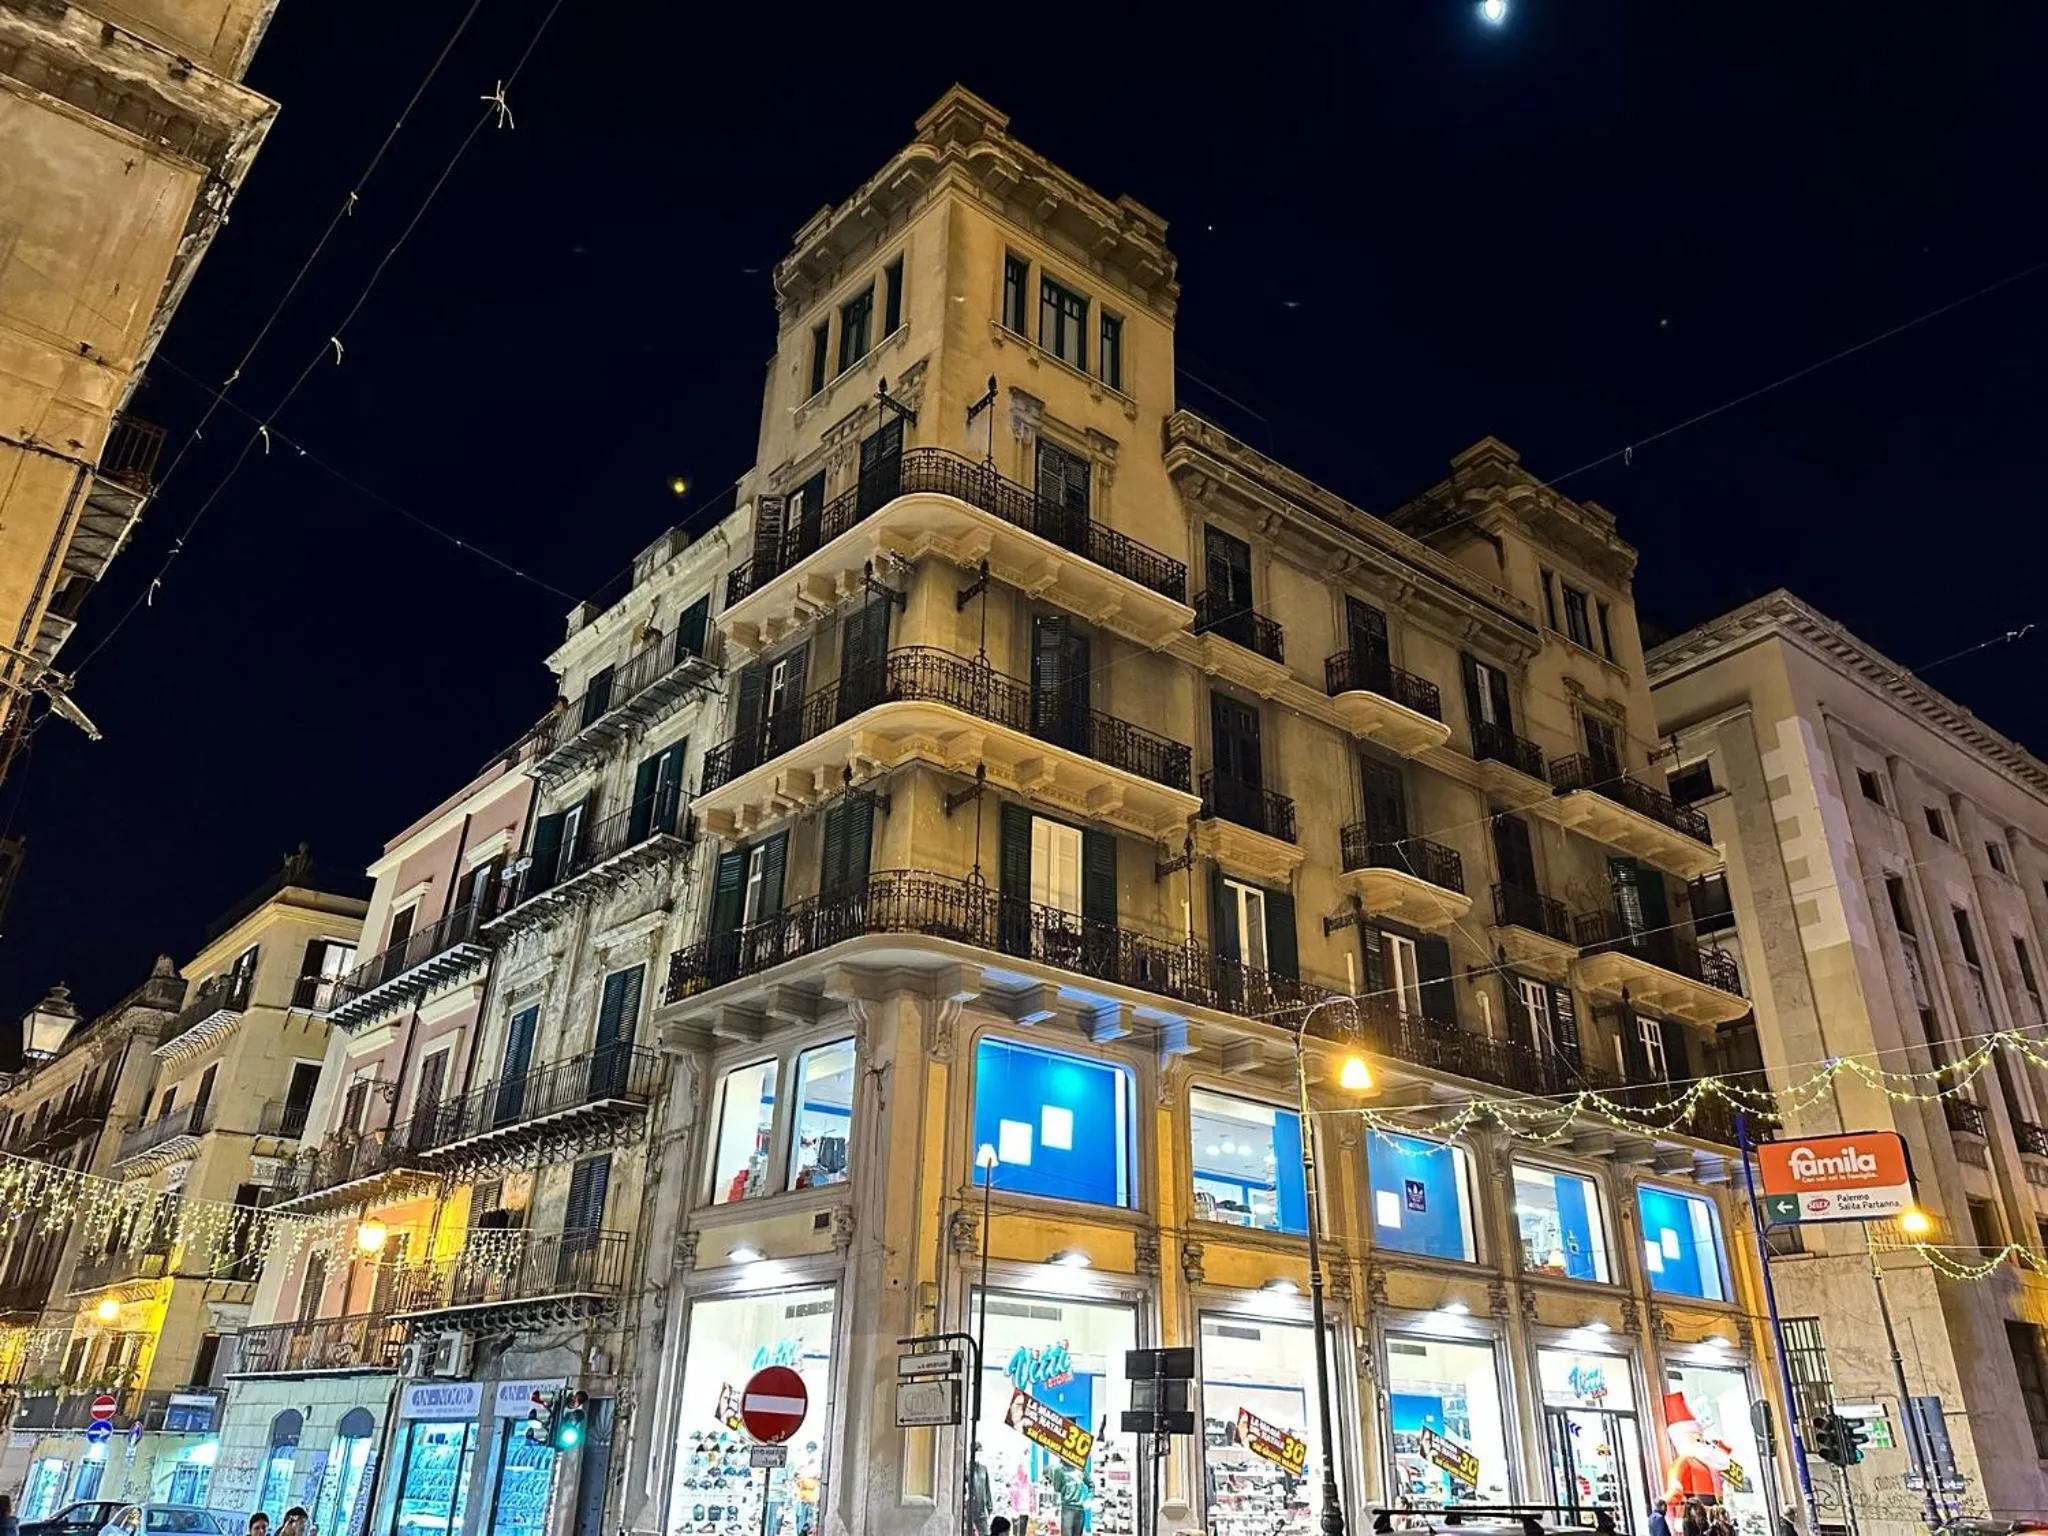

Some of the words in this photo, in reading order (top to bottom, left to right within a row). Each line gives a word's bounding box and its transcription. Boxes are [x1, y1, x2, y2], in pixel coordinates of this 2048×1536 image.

[1788, 1146, 1877, 1180] famila
[1837, 1193, 1870, 1202] Palermo
[1838, 1201, 1861, 1211] Salita
[1063, 1424, 1091, 1456] 30
[1282, 1436, 1305, 1464] 30
[1460, 1452, 1477, 1477] 30
